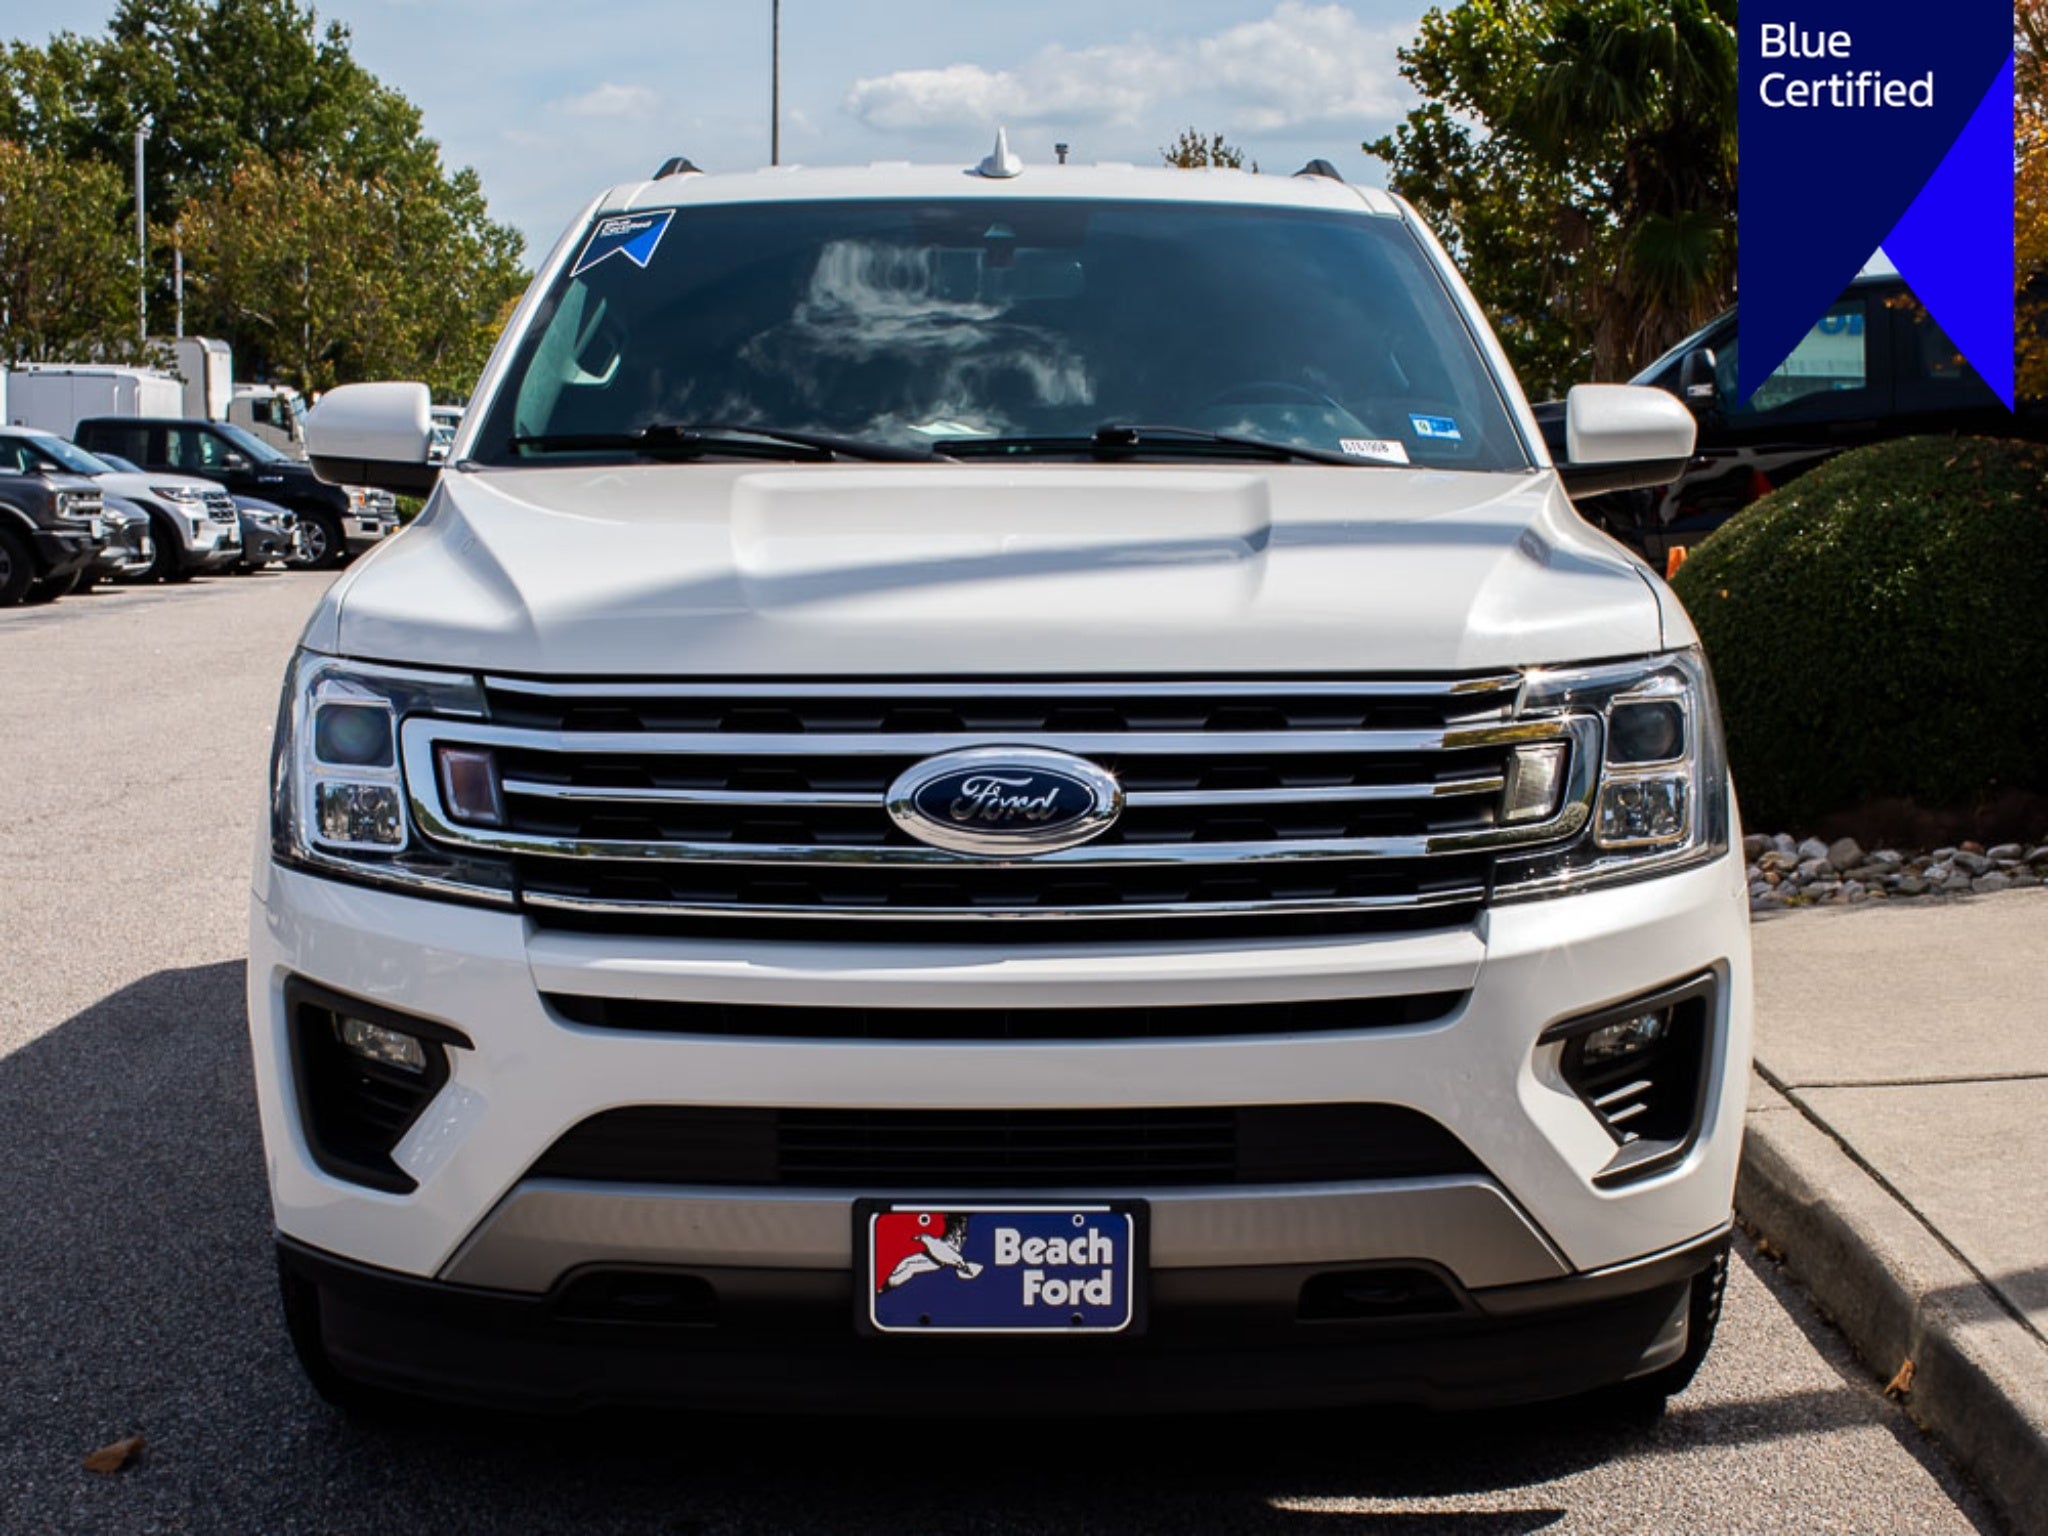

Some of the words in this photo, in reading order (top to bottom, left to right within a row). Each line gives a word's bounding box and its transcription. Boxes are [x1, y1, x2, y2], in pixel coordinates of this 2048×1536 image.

[951, 775, 1059, 821] Ford
[994, 1227, 1113, 1266] Beach
[1023, 1269, 1112, 1306] Ford
